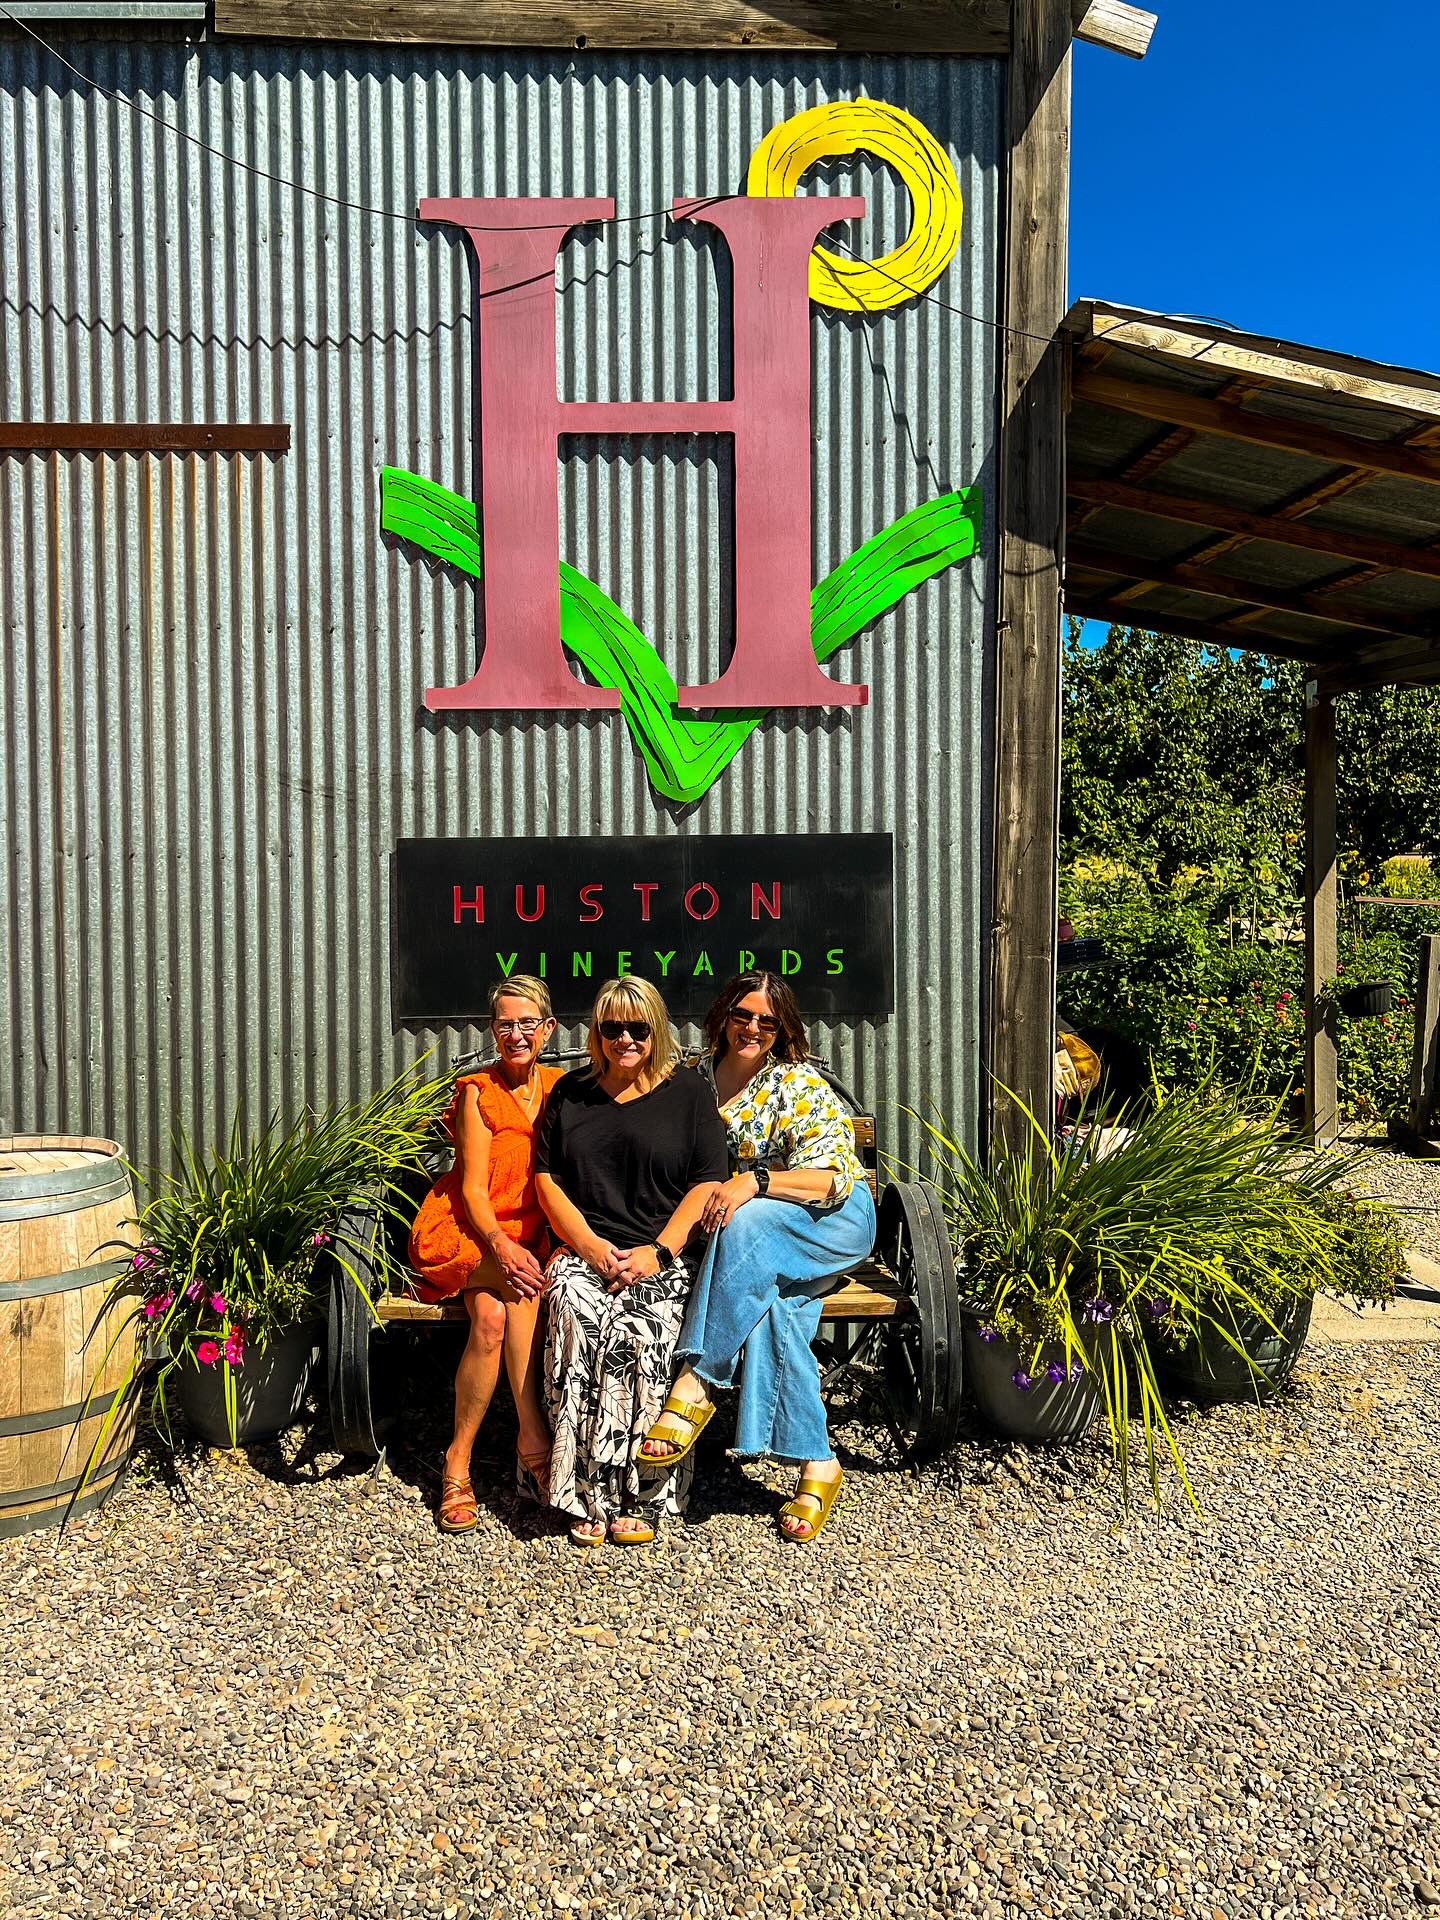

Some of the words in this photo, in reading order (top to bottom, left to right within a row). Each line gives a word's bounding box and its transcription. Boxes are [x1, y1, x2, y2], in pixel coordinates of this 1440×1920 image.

[420, 197, 868, 710] H
[453, 881, 781, 924] HUSTON
[496, 949, 845, 978] VINEYARDS
